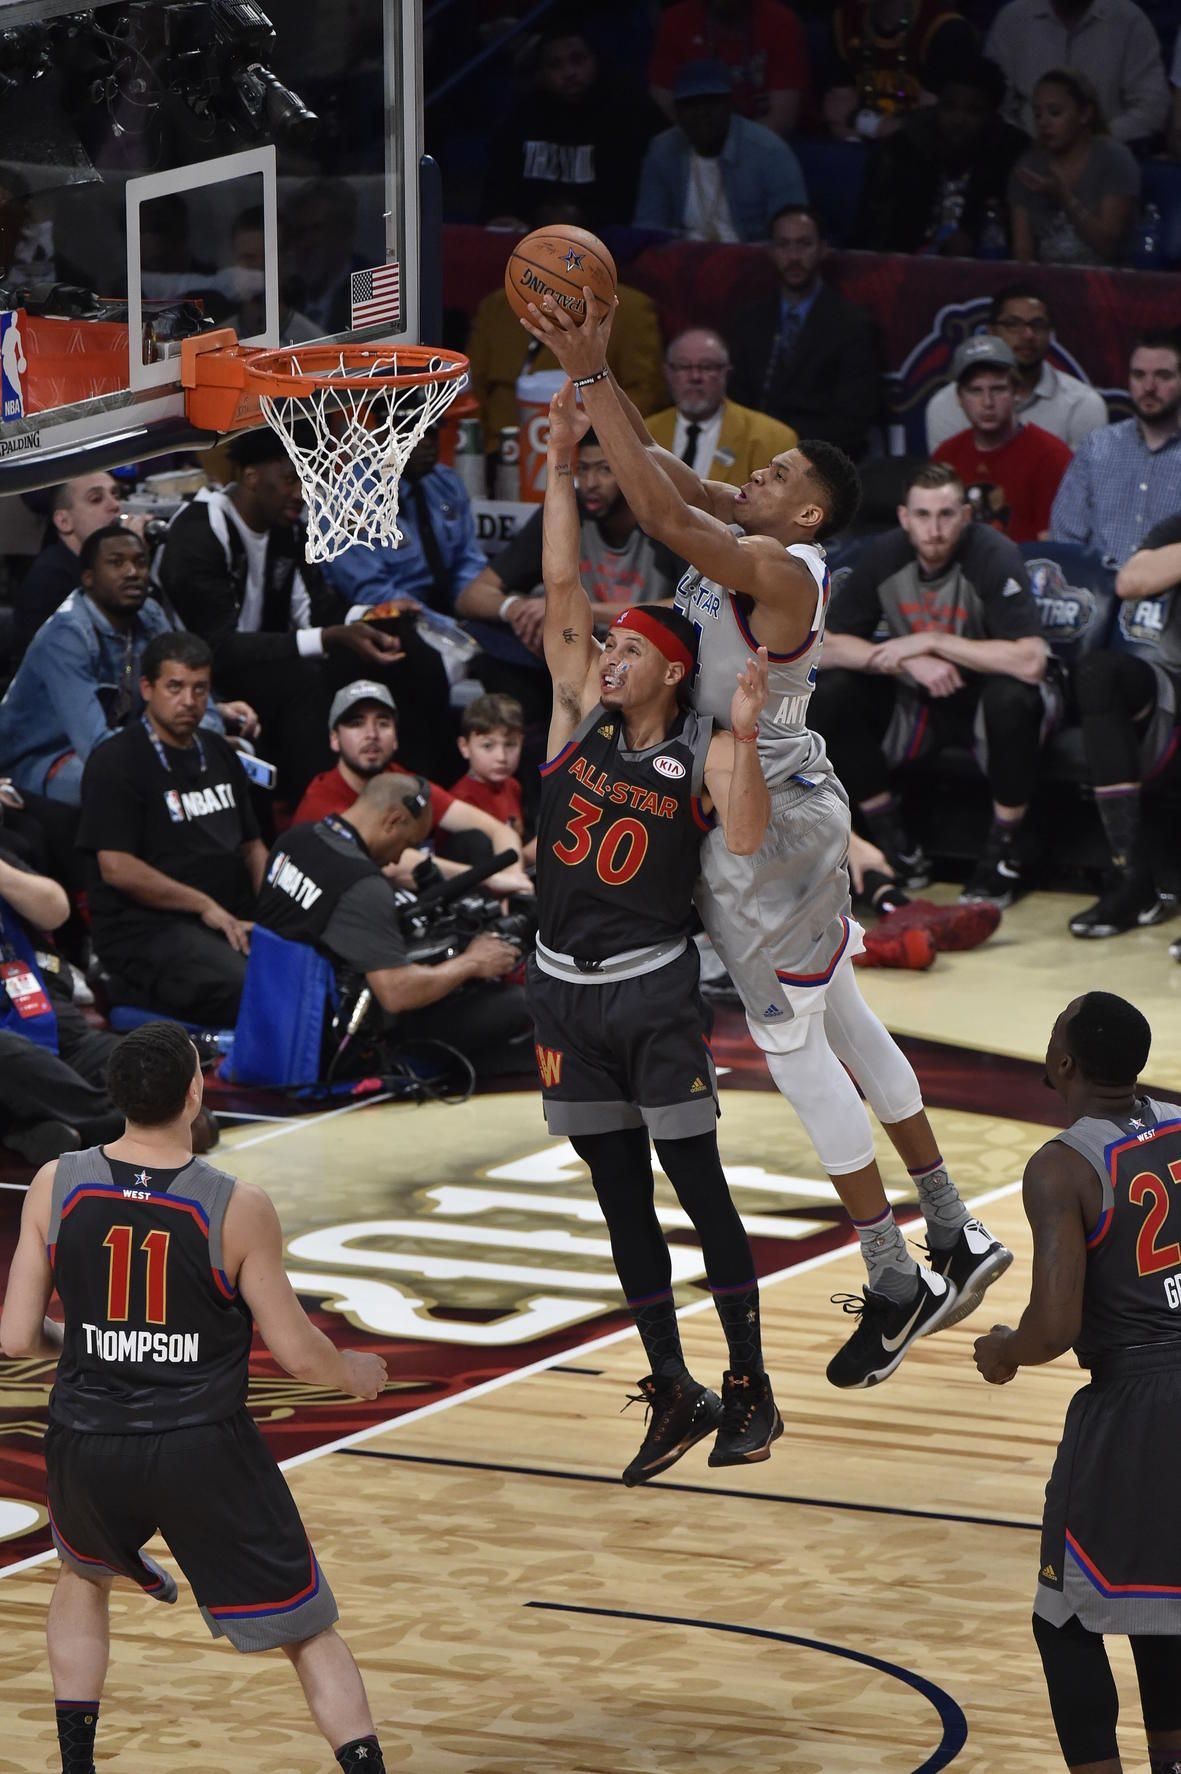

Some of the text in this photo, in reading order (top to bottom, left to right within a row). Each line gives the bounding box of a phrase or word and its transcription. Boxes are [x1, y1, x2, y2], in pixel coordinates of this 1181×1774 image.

[4, 398, 21, 417] NBA
[0, 430, 40, 457] PALDING
[659, 759, 681, 775] KIA
[551, 792, 649, 886] 30
[1136, 1128, 1156, 1143] WEST
[122, 1189, 152, 1201] WEST
[1129, 1158, 1181, 1278] 2
[102, 1224, 170, 1326] 11
[82, 1322, 200, 1363] THOMPSON
